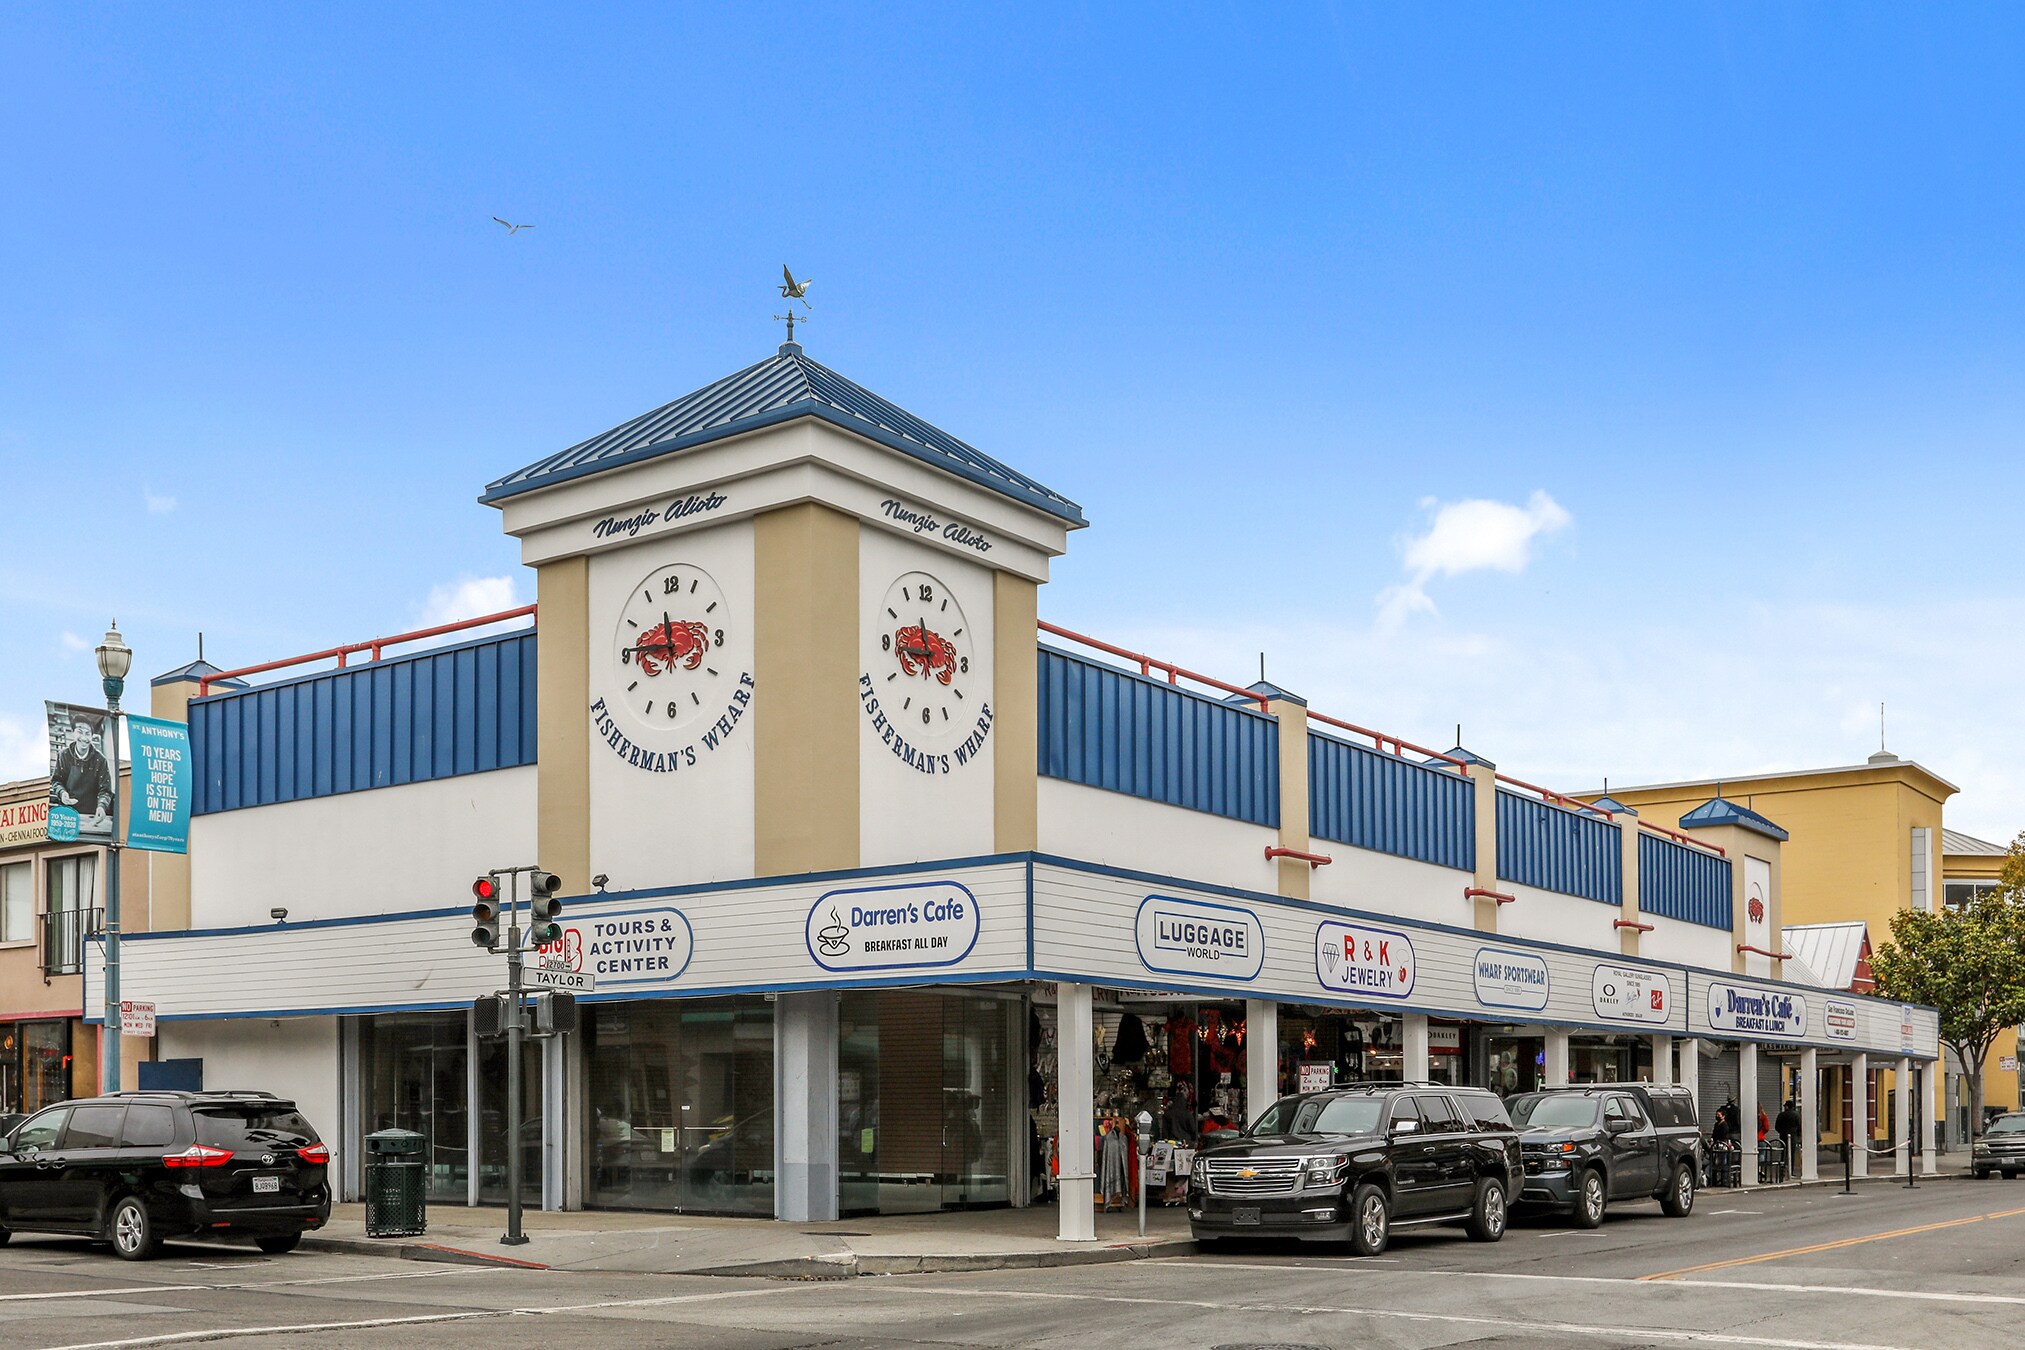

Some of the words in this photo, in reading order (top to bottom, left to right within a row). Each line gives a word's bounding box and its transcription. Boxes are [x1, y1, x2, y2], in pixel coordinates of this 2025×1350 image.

[593, 508, 660, 538] Nunzio
[664, 492, 727, 522] Alioto
[881, 500, 940, 532] Nunzio
[943, 523, 992, 552] Alioto
[664, 576, 679, 594] 12
[919, 584, 932, 601] 12
[714, 629, 724, 647] 3
[882, 634, 890, 651] 9
[622, 648, 631, 664] 9
[960, 657, 968, 673] 3
[667, 701, 676, 718] 6
[922, 707, 931, 724] 6
[590, 697, 696, 772] FISHERMAN'S
[701, 672, 755, 751] WHARF
[859, 673, 950, 774] FISHERMAN'S
[954, 703, 994, 766] WHARF
[141, 726, 185, 740] ANTHONY'S
[141, 745, 152, 757] 70
[153, 746, 181, 761] YEARS
[148, 758, 176, 774] LATER,
[151, 772, 173, 785] HOPE
[146, 784, 154, 795] IS
[157, 785, 178, 799] STILL
[147, 797, 158, 809] ON
[161, 798, 176, 811] THE
[149, 810, 173, 823] MENU
[8, 829, 33, 842] CHENNAI
[851, 903, 919, 928] Darren's
[923, 898, 964, 923] Cafe
[595, 920, 655, 937] TOURS
[660, 919, 672, 931] &
[1160, 921, 1244, 949] LUGGAGE
[589, 937, 676, 956] ACTIVITY
[864, 938, 912, 953] BREAKFAST
[914, 937, 929, 950] ALL
[931, 936, 948, 949] DAY
[1344, 935, 1355, 962] R
[1364, 940, 1373, 961] &
[1379, 940, 1390, 967] K
[1187, 947, 1220, 960] WORLD
[550, 962, 564, 970] 2700
[597, 957, 669, 974] CENTER
[1478, 962, 1502, 980] WHARF
[1504, 965, 1545, 985] SPORTSWEAR
[536, 973, 584, 987] TAYLOR
[1341, 966, 1393, 988] JEWELRY
[121, 1002, 132, 1012] NO
[1600, 997, 1619, 1005] OAKLEY
[1727, 989, 1770, 1017] Darren's
[1772, 994, 1793, 1019] Café
[1735, 1015, 1765, 1030] BREAKFAST
[1769, 1020, 1785, 1032] LUNCH
[1301, 1065, 1310, 1075] NO
